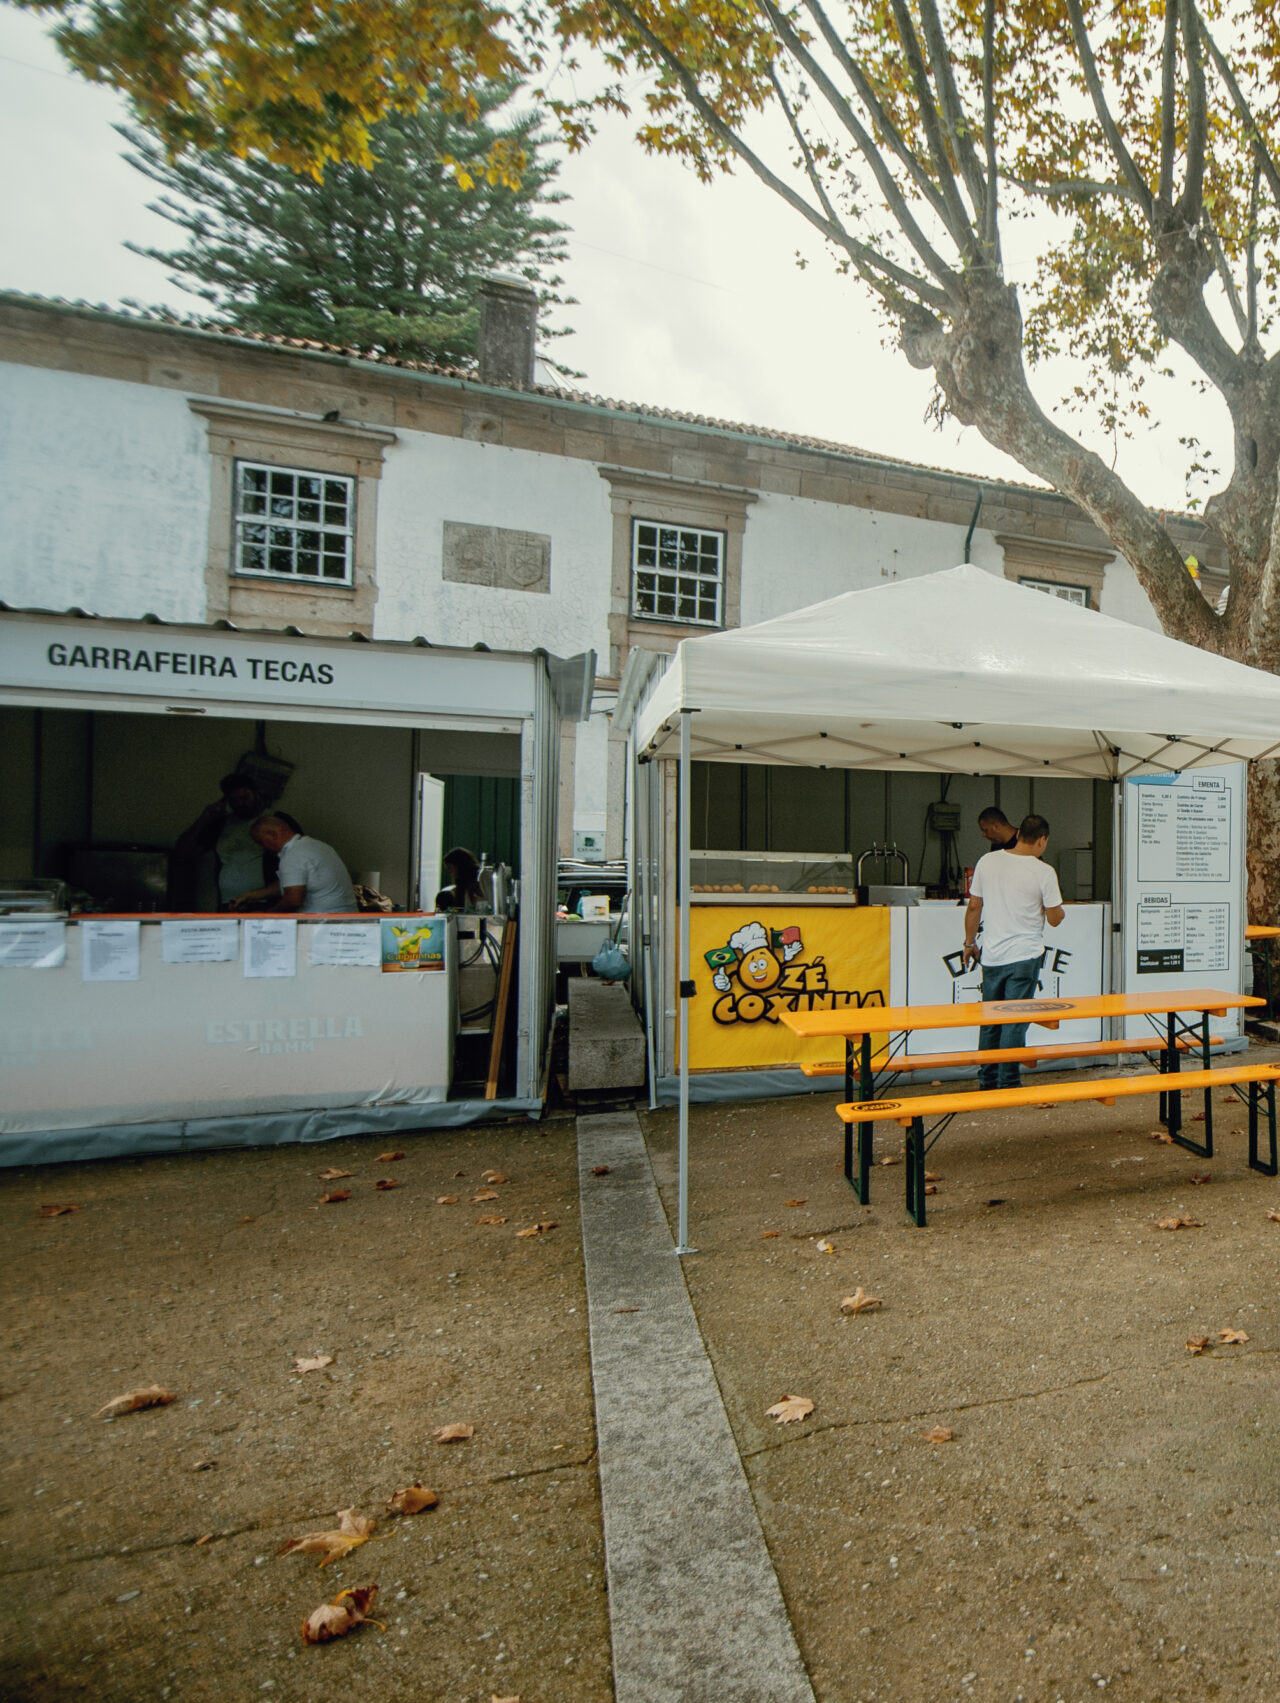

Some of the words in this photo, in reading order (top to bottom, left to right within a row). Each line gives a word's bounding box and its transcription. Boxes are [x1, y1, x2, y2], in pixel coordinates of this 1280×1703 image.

[48, 643, 238, 678] GARRAFEIRA
[246, 658, 334, 685] TECAS
[778, 956, 829, 992] ZÉ
[206, 1015, 364, 1044] ESTRELLA
